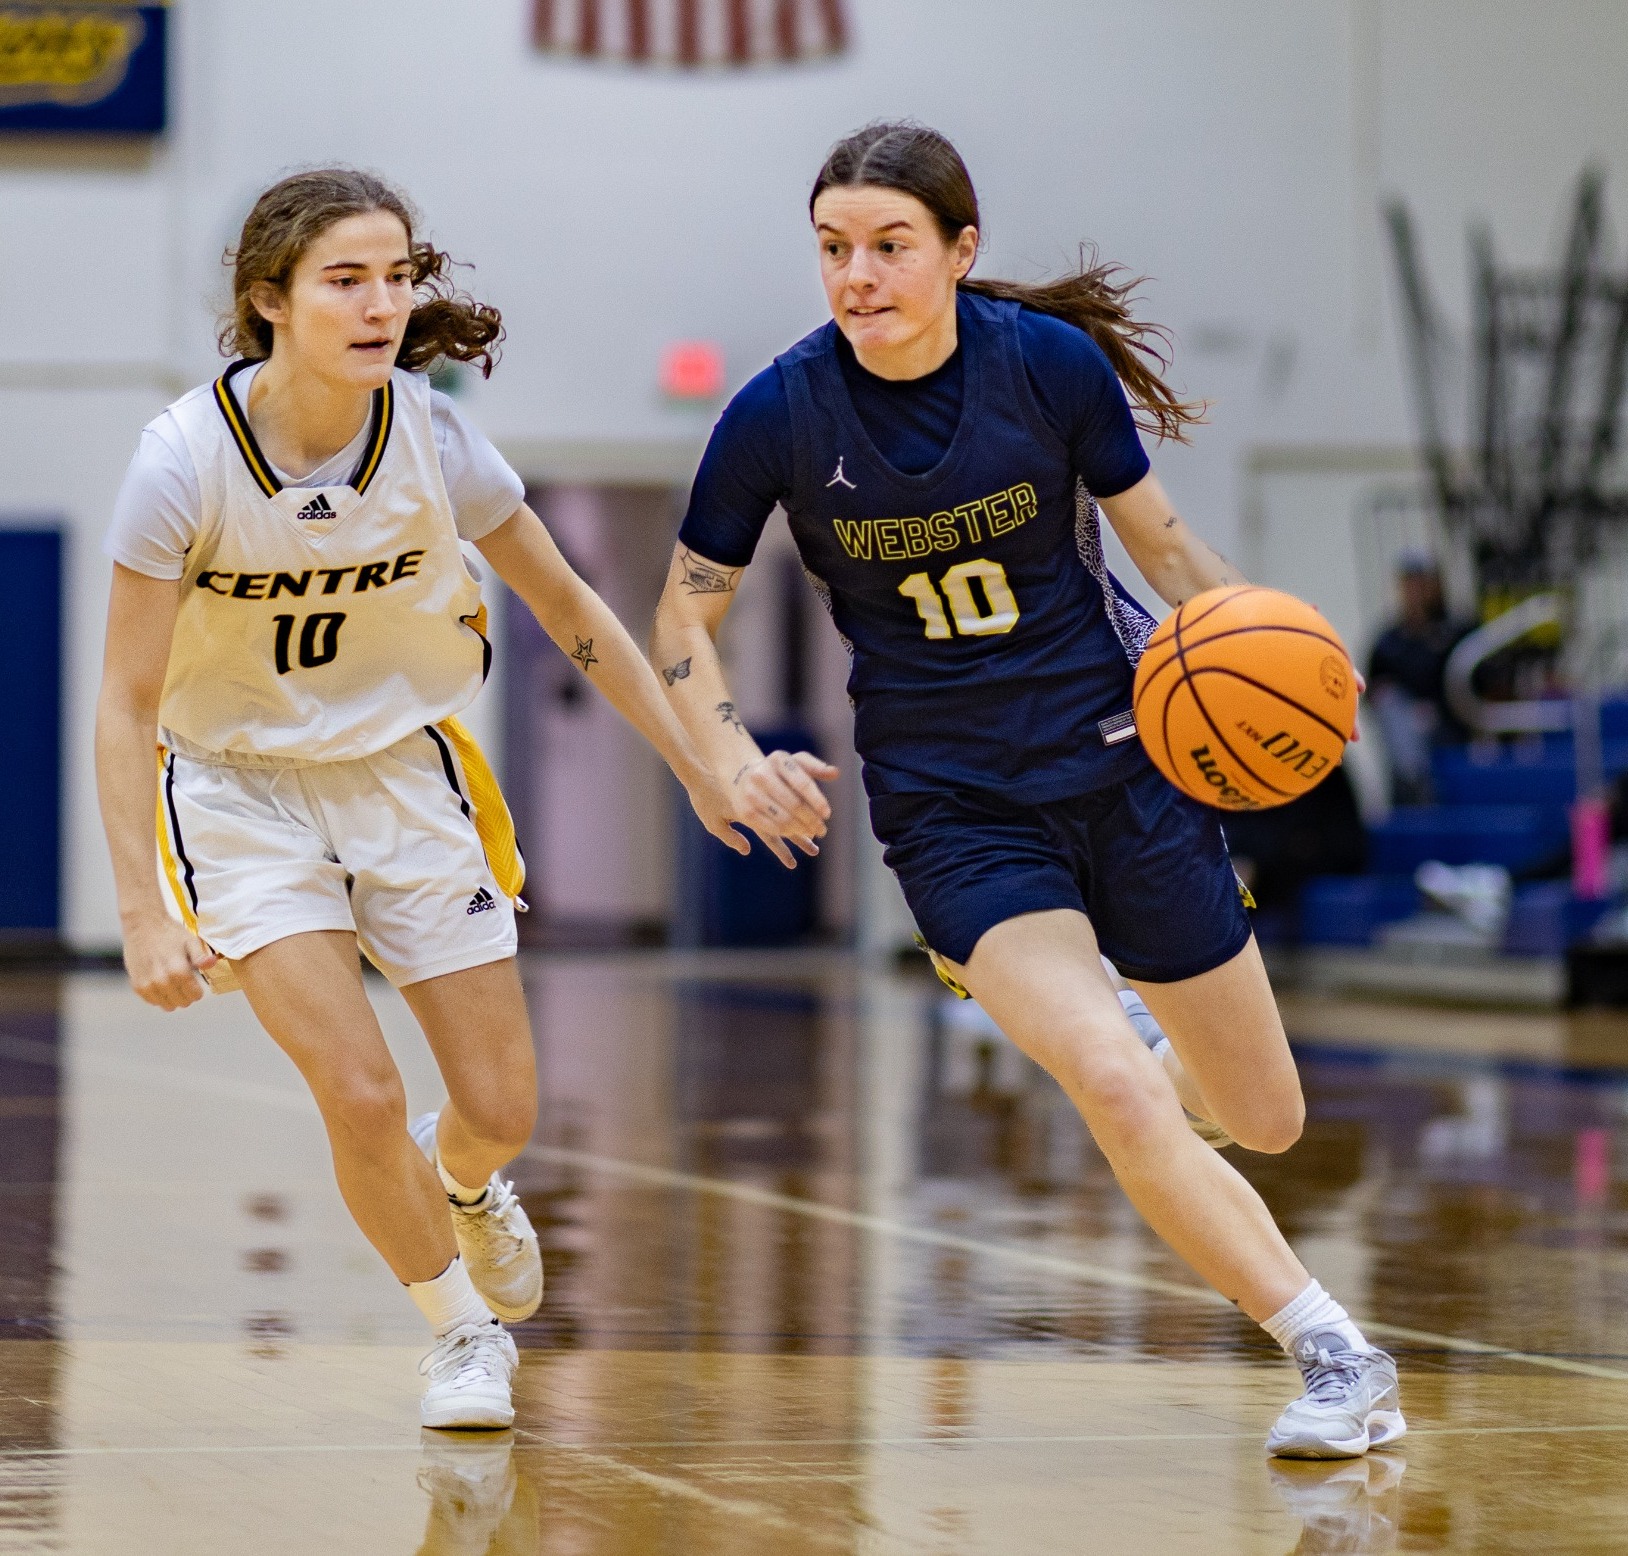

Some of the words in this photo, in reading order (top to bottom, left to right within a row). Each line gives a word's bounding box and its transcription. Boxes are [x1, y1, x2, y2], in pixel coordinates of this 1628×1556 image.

[297, 509, 337, 520] adidas
[833, 482, 1038, 560] WEBSTER
[196, 550, 427, 600] CENTRE
[897, 558, 1020, 640] 10
[273, 612, 347, 676] 10
